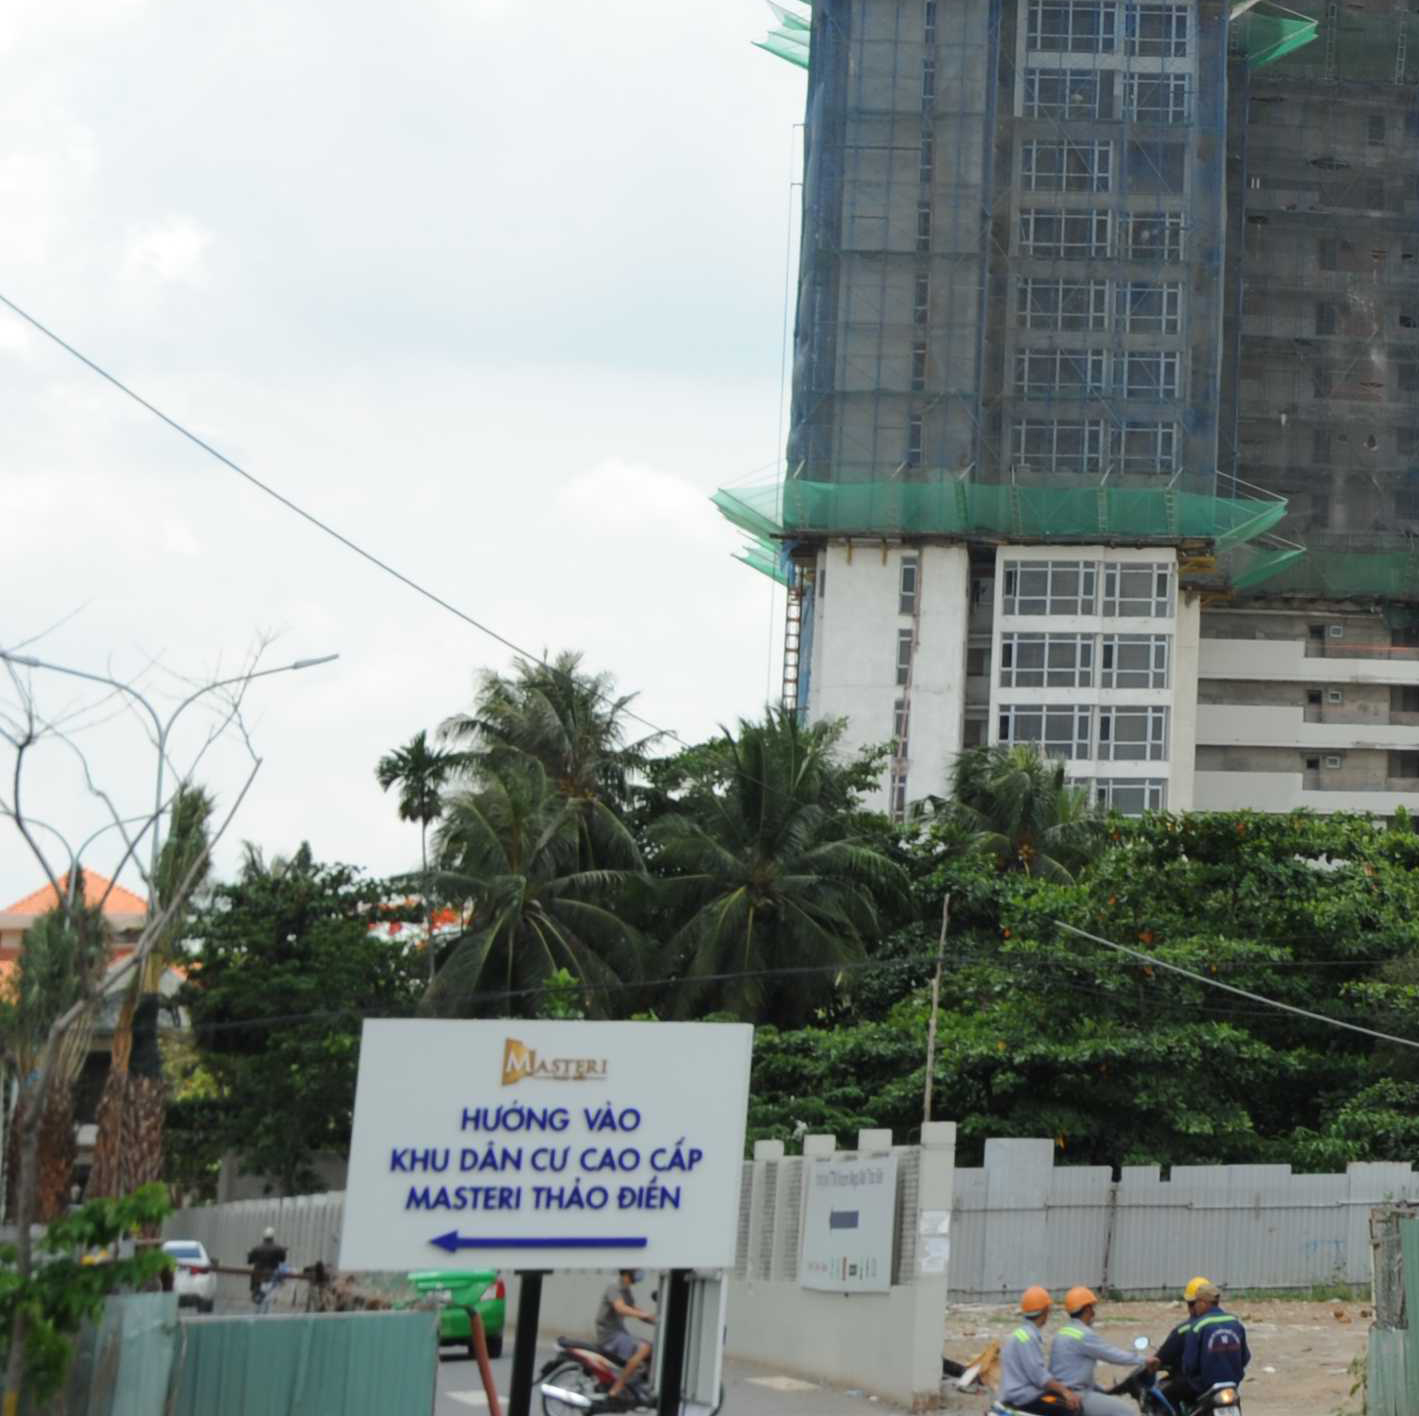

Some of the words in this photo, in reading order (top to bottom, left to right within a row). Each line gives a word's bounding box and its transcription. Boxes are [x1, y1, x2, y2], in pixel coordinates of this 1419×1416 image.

[390, 1147, 450, 1172] KHU
[531, 1146, 571, 1172] CƯ
[580, 1147, 641, 1172] CAO
[405, 1186, 521, 1211] MASTERI
